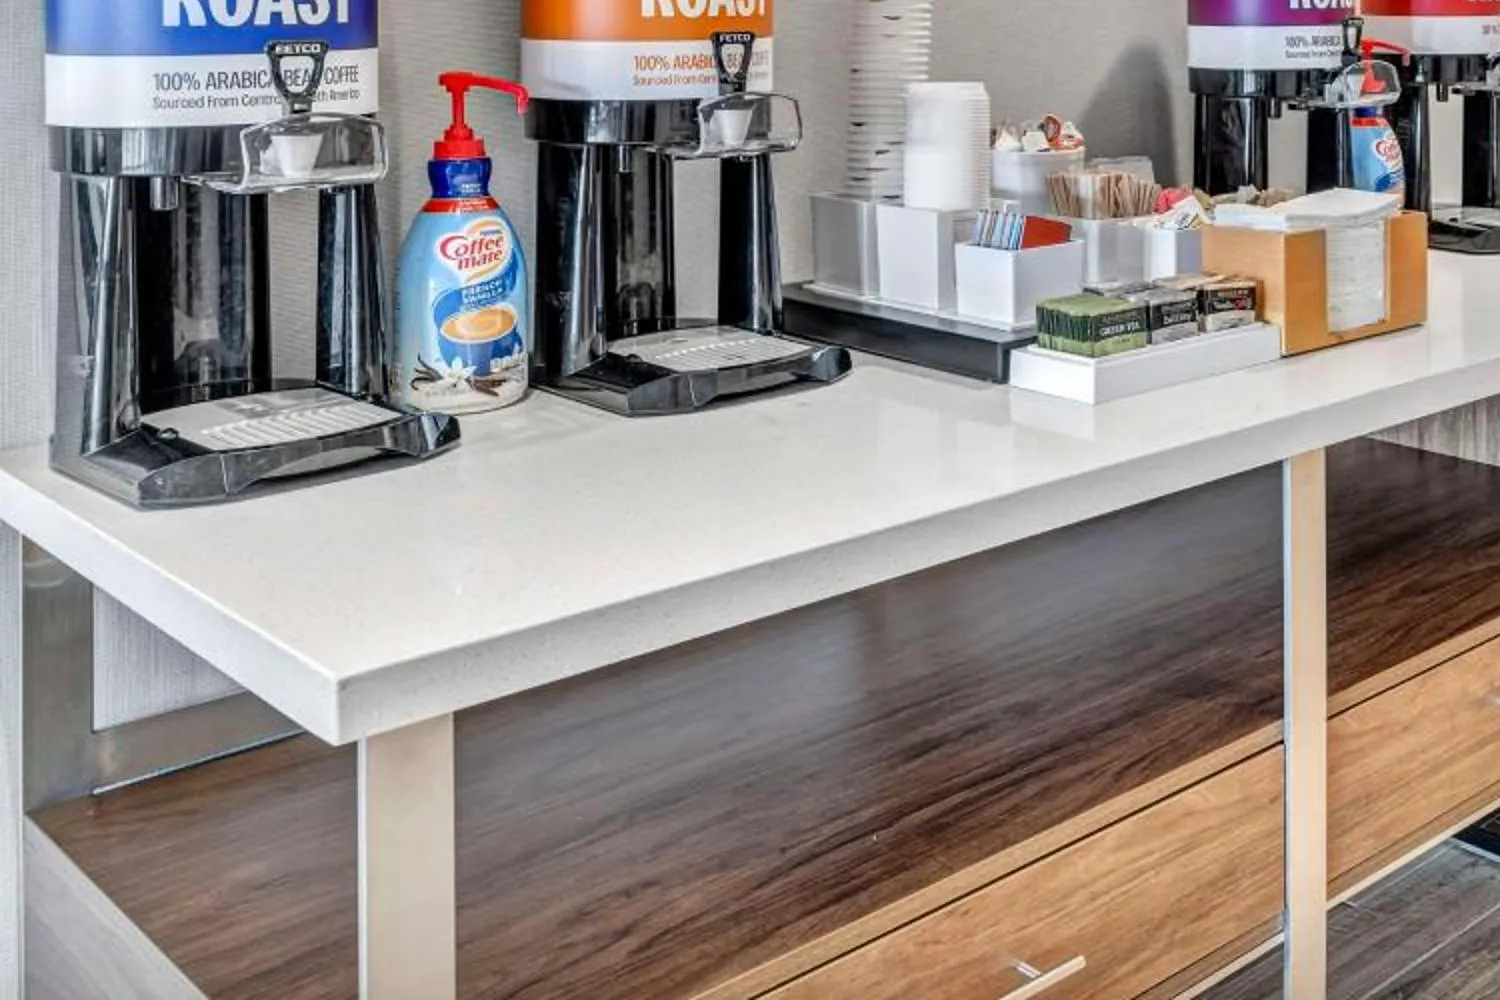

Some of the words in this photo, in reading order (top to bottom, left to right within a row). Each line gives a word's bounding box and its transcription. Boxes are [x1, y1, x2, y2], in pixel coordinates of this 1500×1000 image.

[720, 33, 751, 42] FETCO
[275, 43, 321, 53] FETCO
[634, 55, 669, 71] 100%
[153, 72, 200, 92] 100%
[283, 68, 313, 87] BEA
[324, 65, 360, 86] COFFEE
[153, 95, 205, 110] Sourced
[207, 95, 239, 108] From
[241, 93, 282, 107] Centra
[440, 234, 505, 261] Coffee
[457, 250, 503, 271] mate
